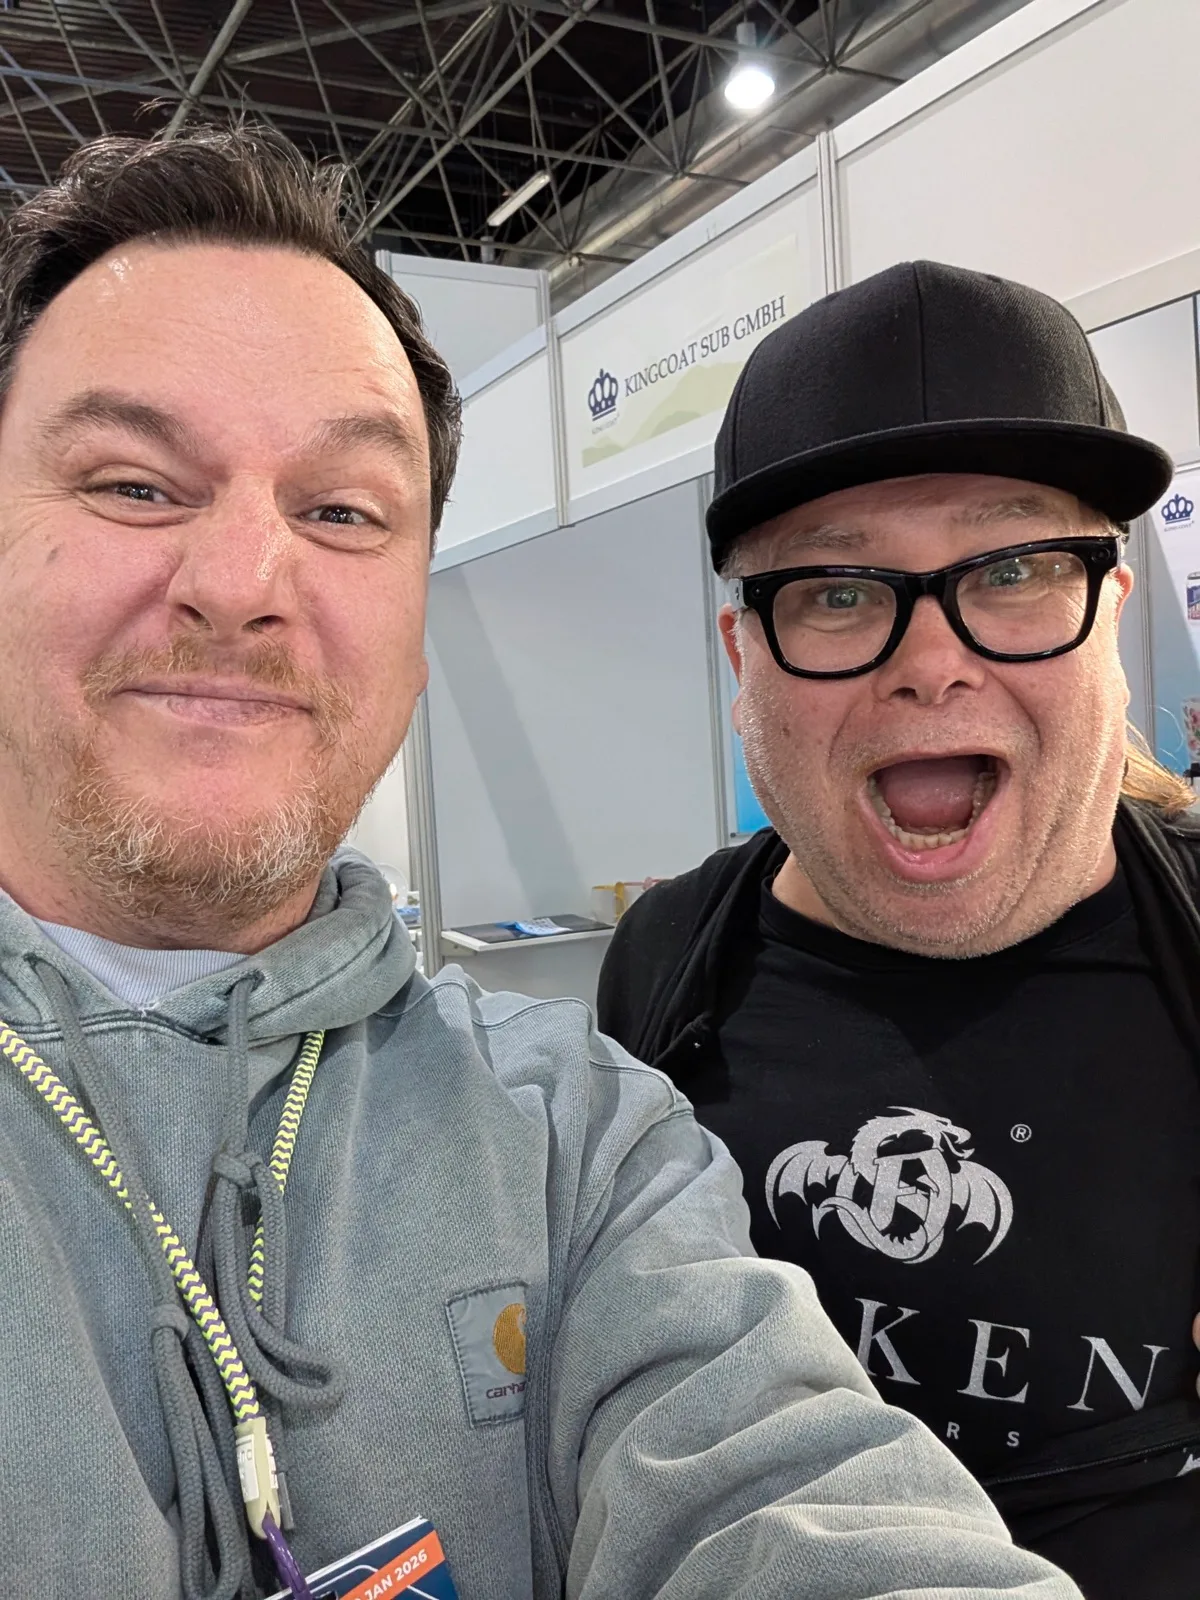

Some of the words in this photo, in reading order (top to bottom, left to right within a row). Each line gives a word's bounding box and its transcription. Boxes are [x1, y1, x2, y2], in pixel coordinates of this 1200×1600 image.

[623, 342, 698, 397] KINGCOAT
[700, 325, 730, 359] SUB
[732, 295, 786, 341] GMBH
[364, 1574, 393, 1600] JAN
[394, 1548, 428, 1581] 2026
